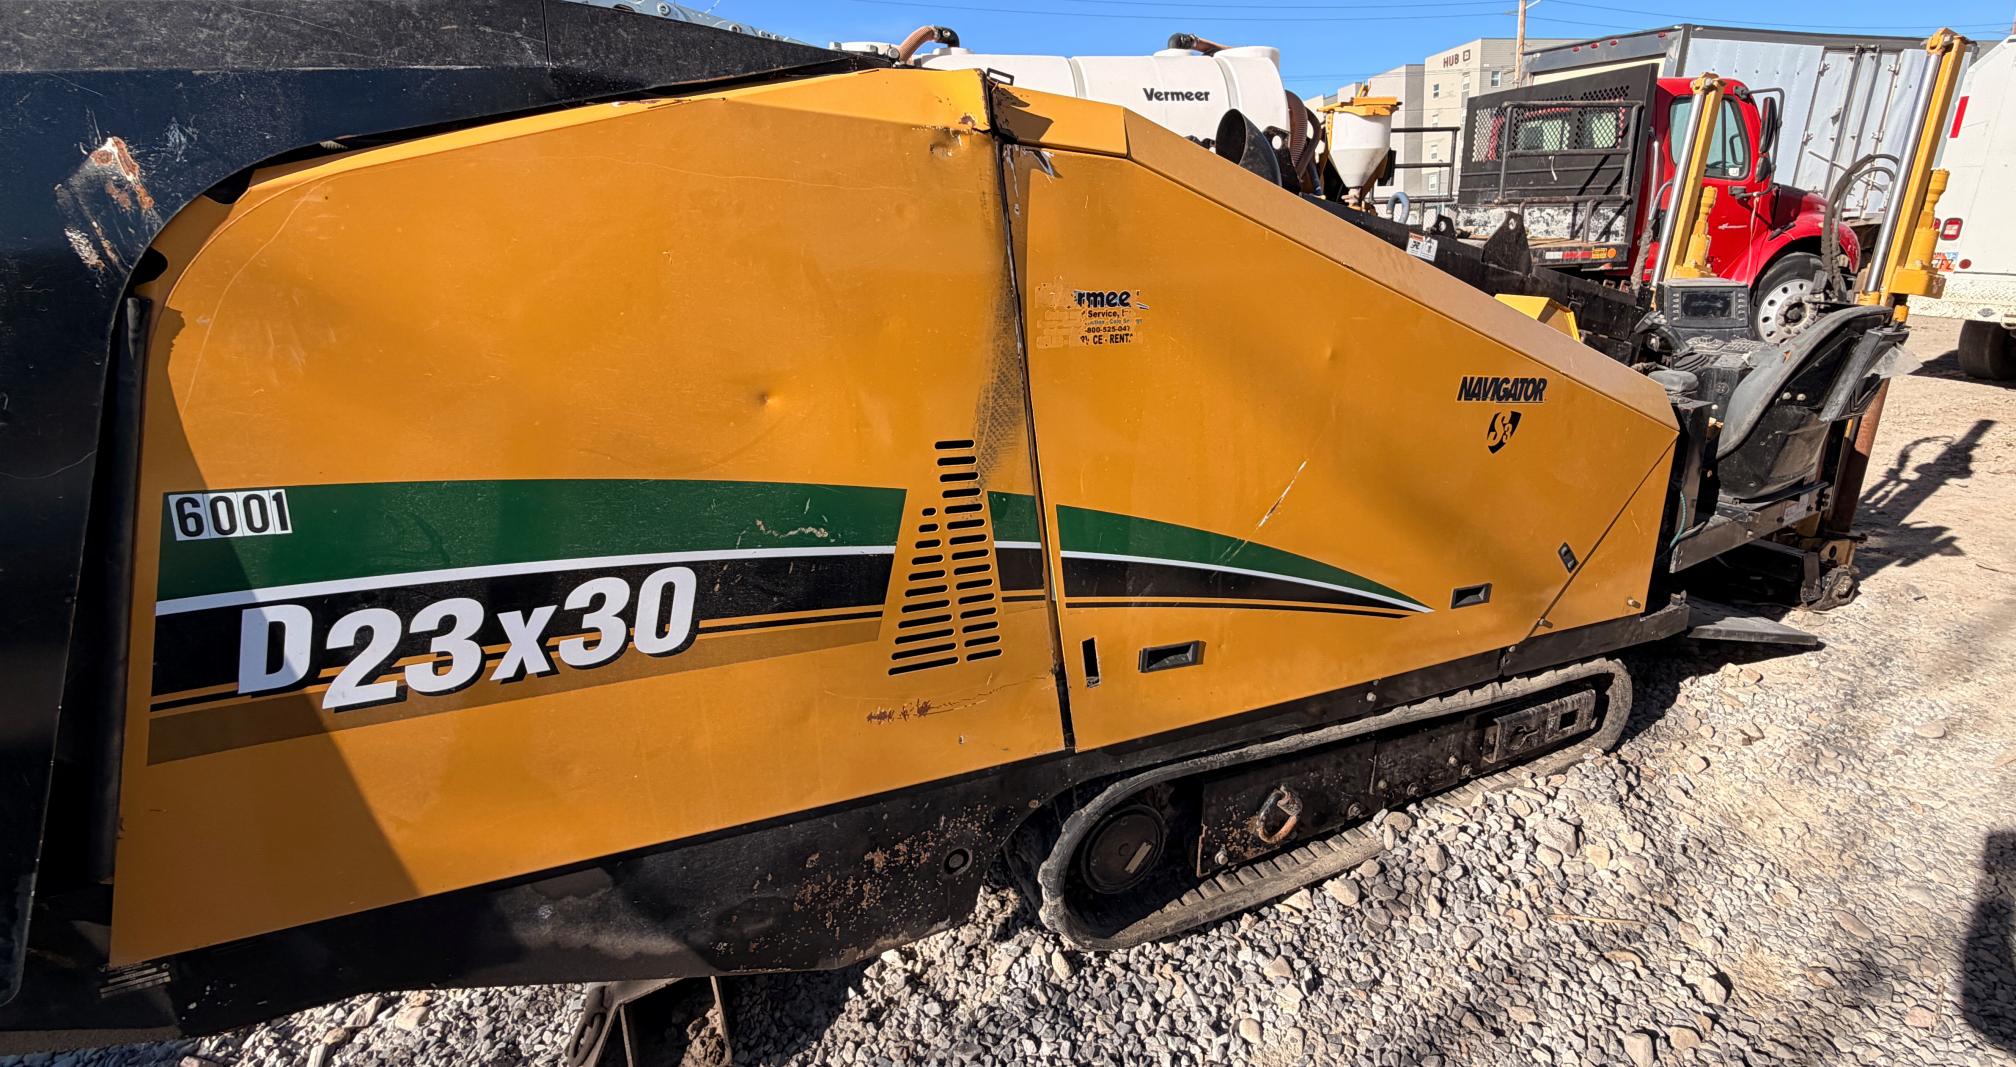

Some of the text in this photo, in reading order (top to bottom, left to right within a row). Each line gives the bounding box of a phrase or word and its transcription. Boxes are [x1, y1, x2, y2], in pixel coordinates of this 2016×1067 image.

[1443, 53, 1459, 68] HUB
[1142, 87, 1210, 101] Vermeer
[1087, 310, 1120, 318] Service,
[1457, 376, 1548, 402] NAVIGATOR
[173, 490, 290, 538] 6001
[237, 565, 699, 710] D23x30
